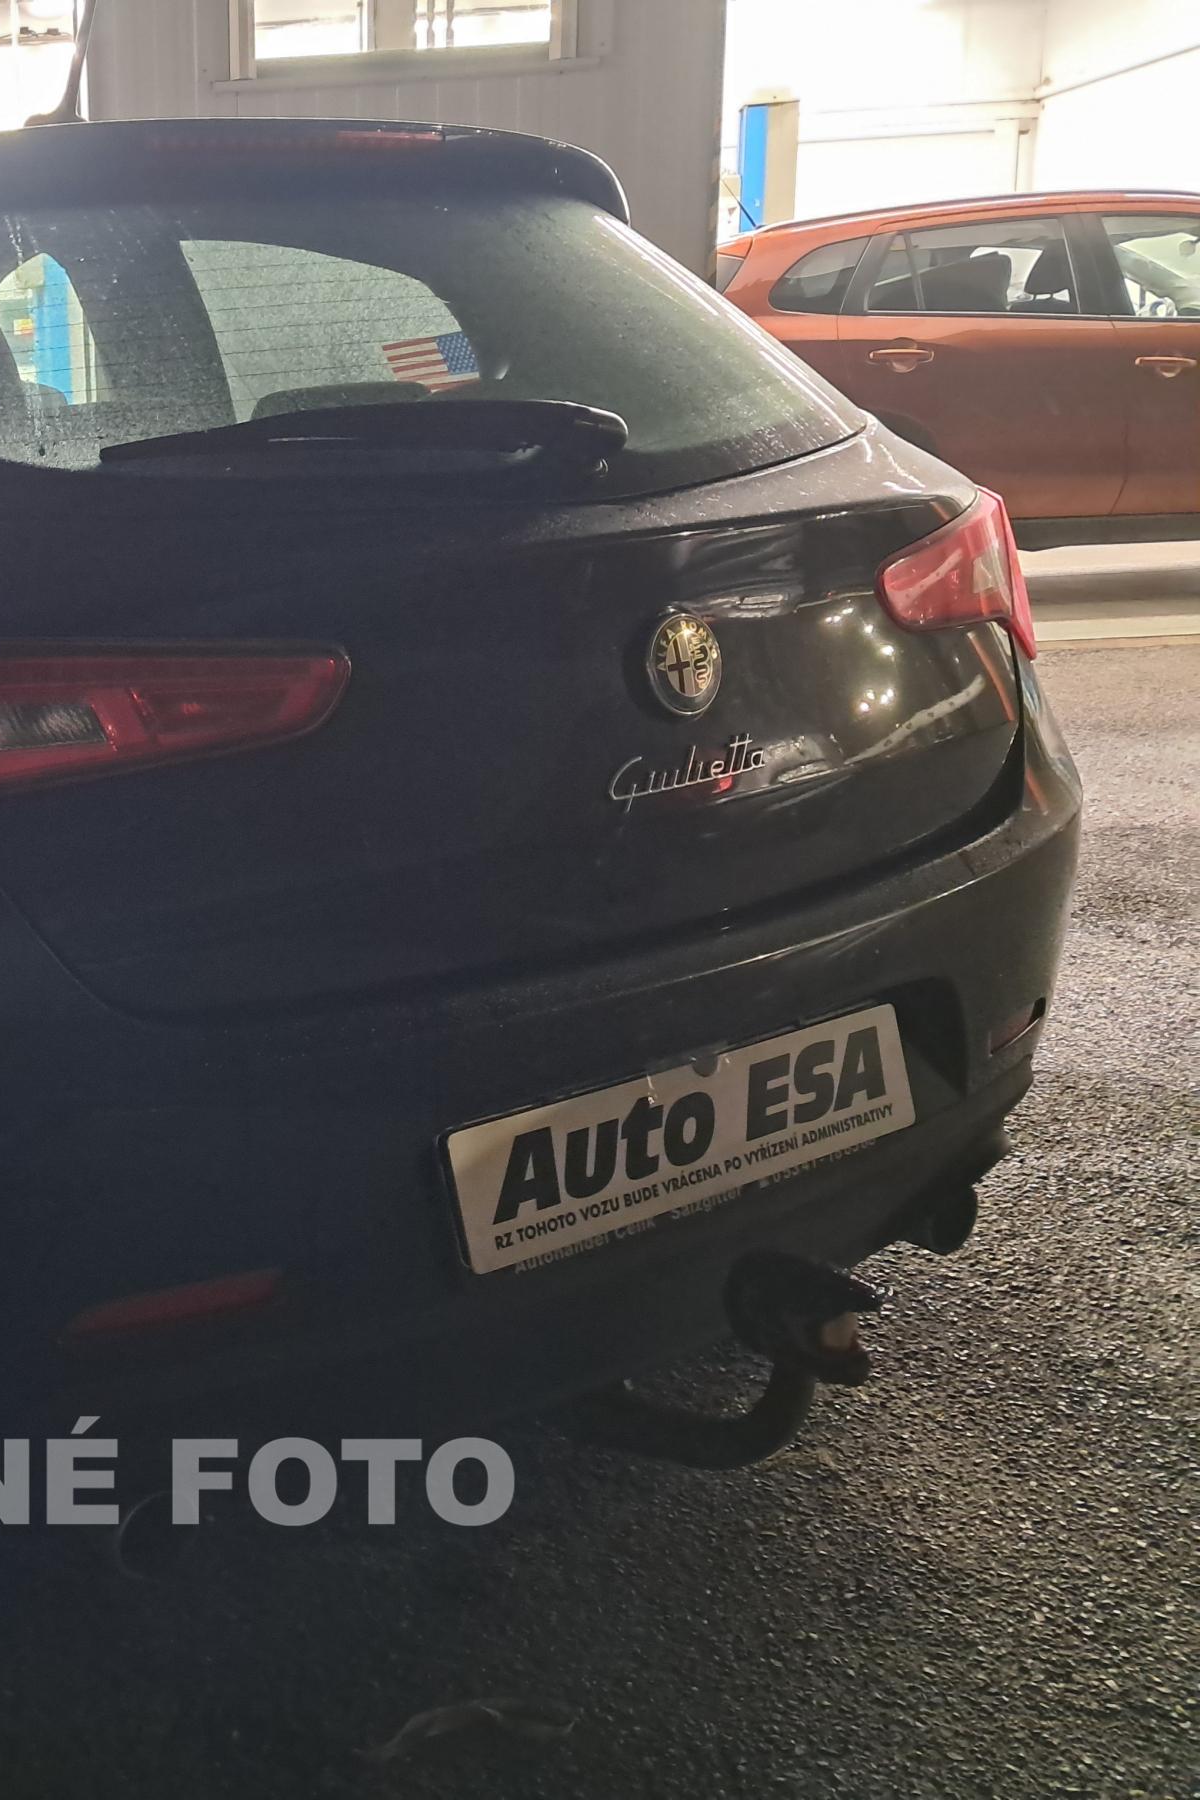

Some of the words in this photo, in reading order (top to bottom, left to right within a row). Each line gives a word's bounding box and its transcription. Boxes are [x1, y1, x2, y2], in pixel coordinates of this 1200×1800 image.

[656, 628, 676, 671] ALFA
[680, 619, 719, 660] ROMEO
[608, 733, 767, 814] Giulietta
[492, 1091, 716, 1226] Auto
[745, 1026, 887, 1142] ESA
[494, 1231, 514, 1250] RZ
[516, 1212, 577, 1243] TOHOTO
[579, 1196, 620, 1222] VOZU
[624, 1183, 660, 1208] BUDE
[661, 1163, 722, 1194] VRÁCENA
[724, 1155, 742, 1174] PO
[744, 1136, 799, 1167] VYŘÍZENÍ
[801, 1103, 894, 1147] ADMINISTRATIVY
